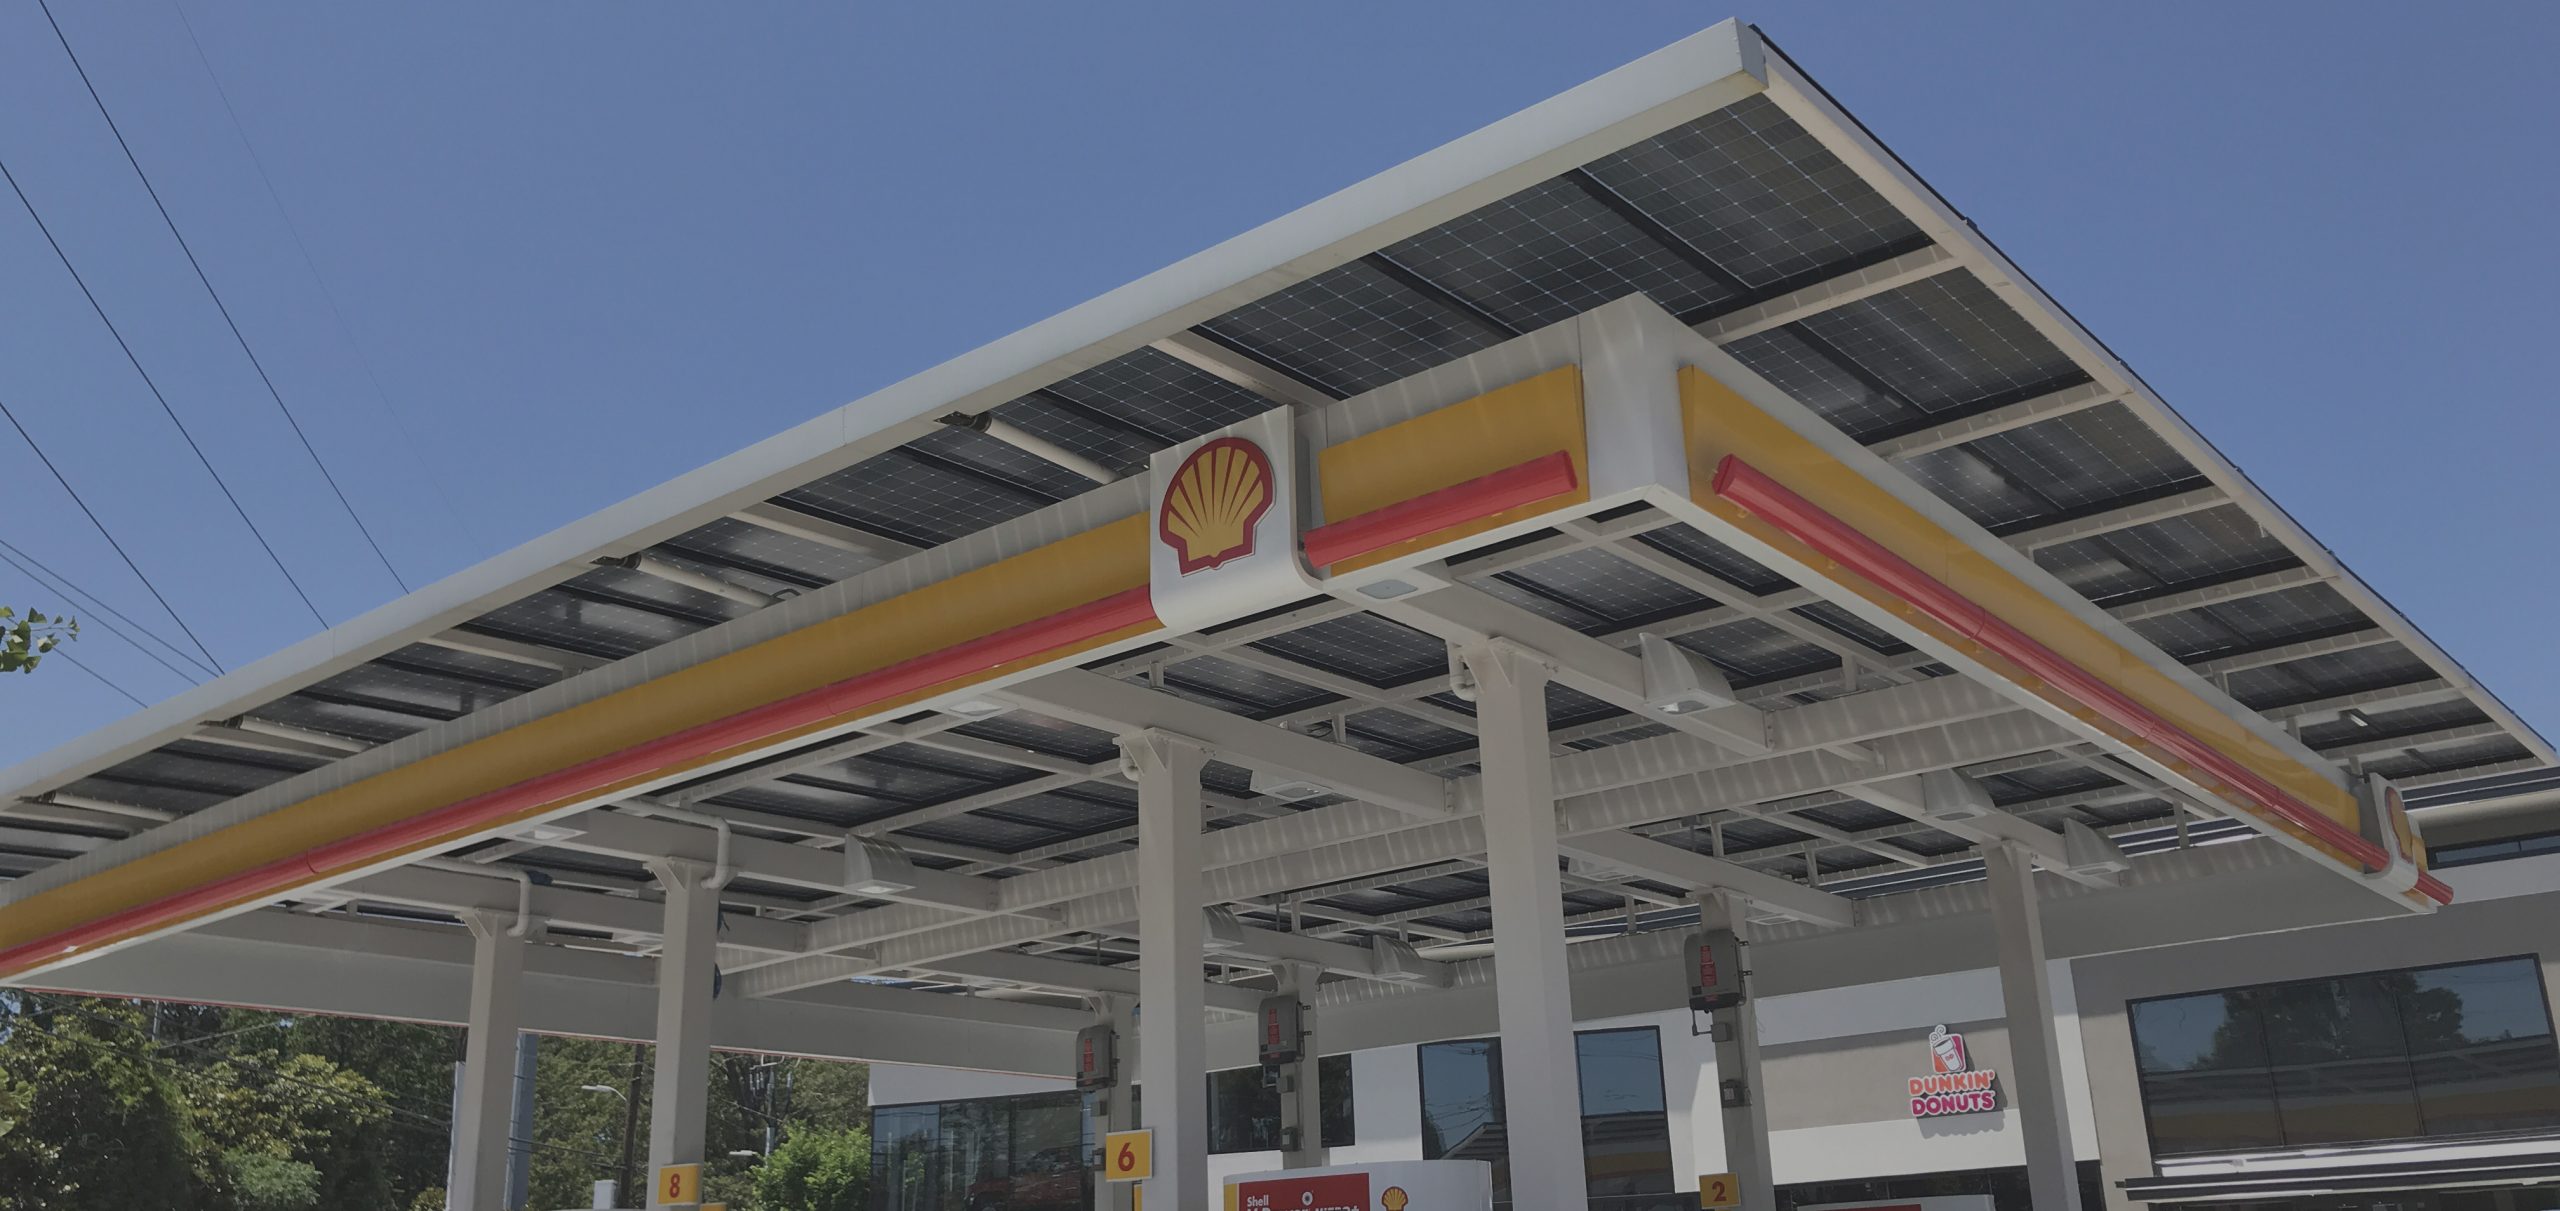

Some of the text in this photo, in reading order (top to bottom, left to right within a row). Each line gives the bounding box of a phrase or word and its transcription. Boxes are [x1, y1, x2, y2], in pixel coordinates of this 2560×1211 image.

[1909, 1070, 1995, 1096] DUNKIN'
[1911, 1091, 1995, 1116] DONUTS
[1118, 1142, 1135, 1172] 6
[669, 1173, 681, 1198] 8
[1711, 1181, 1728, 1201] 2
[1247, 1194, 1269, 1207] Shell
